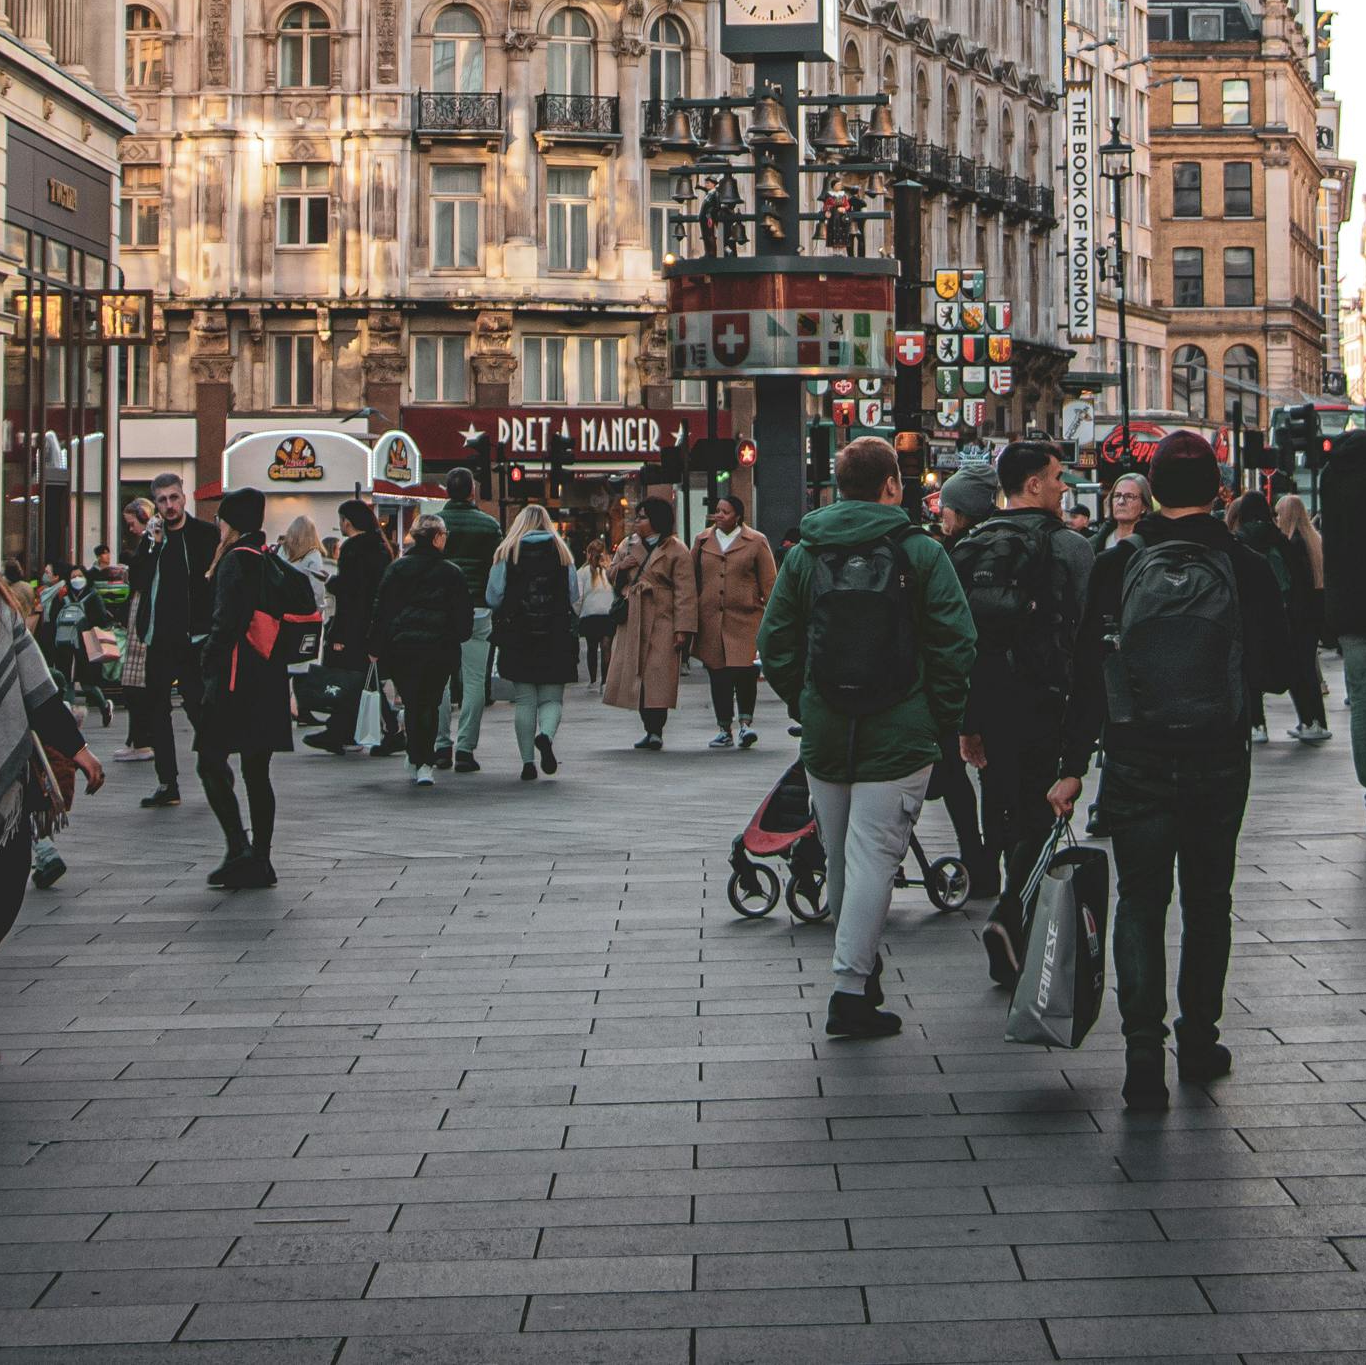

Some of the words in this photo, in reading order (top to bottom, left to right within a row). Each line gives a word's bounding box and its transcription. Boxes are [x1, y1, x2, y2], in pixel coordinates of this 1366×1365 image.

[1072, 98, 1086, 135] THE
[1073, 142, 1087, 199] BOOK
[1073, 204, 1087, 231] OF
[1074, 237, 1088, 327] MORMON
[498, 417, 551, 452] PRET
[581, 417, 661, 452] MANGER
[1037, 919, 1059, 1009] DAINESE
